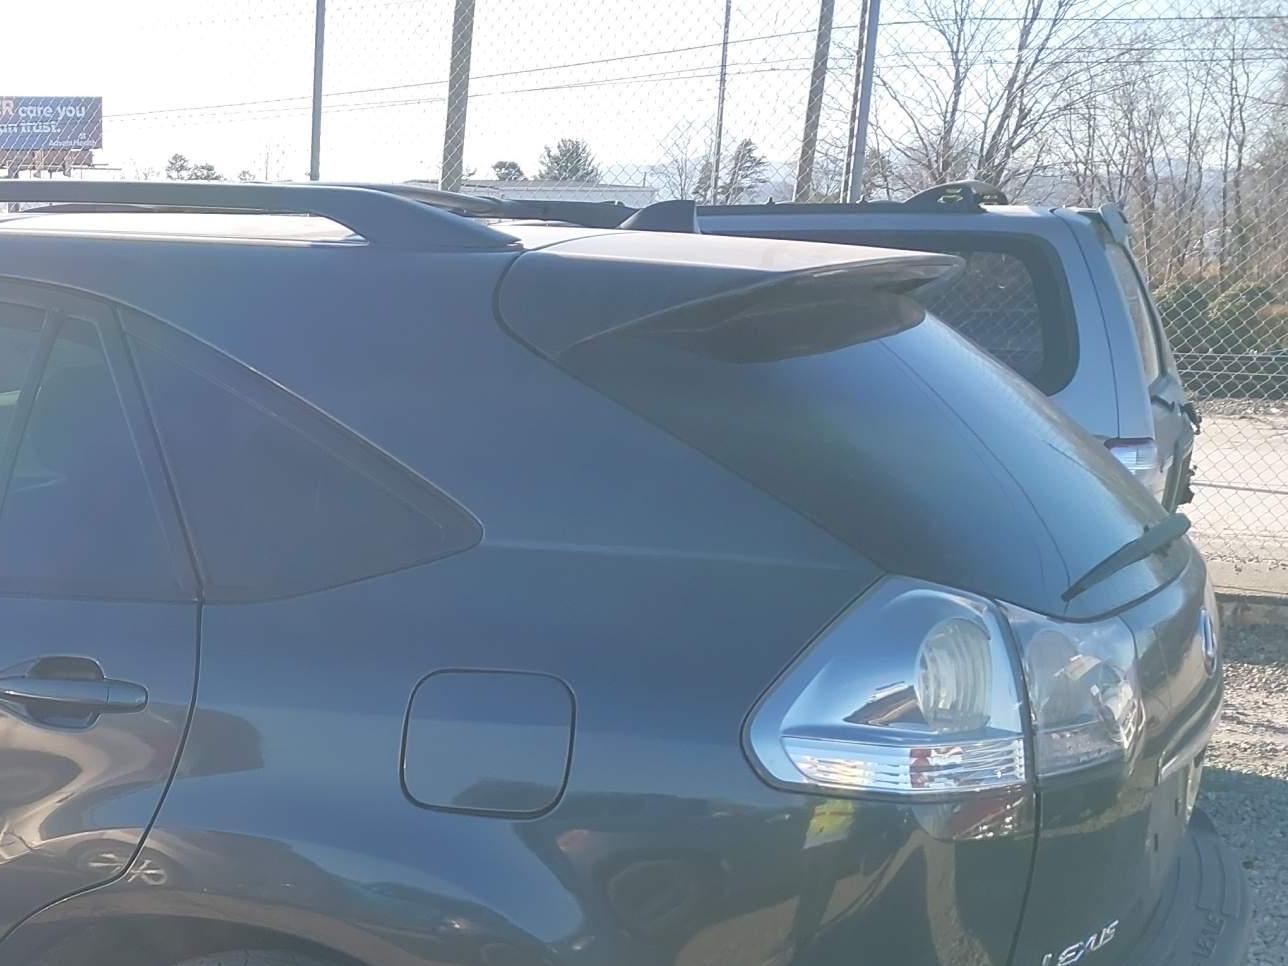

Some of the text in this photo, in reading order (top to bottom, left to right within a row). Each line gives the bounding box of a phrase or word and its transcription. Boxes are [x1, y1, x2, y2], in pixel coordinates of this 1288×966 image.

[18, 105, 53, 117] care
[57, 105, 86, 120] you
[21, 121, 62, 134] trust.
